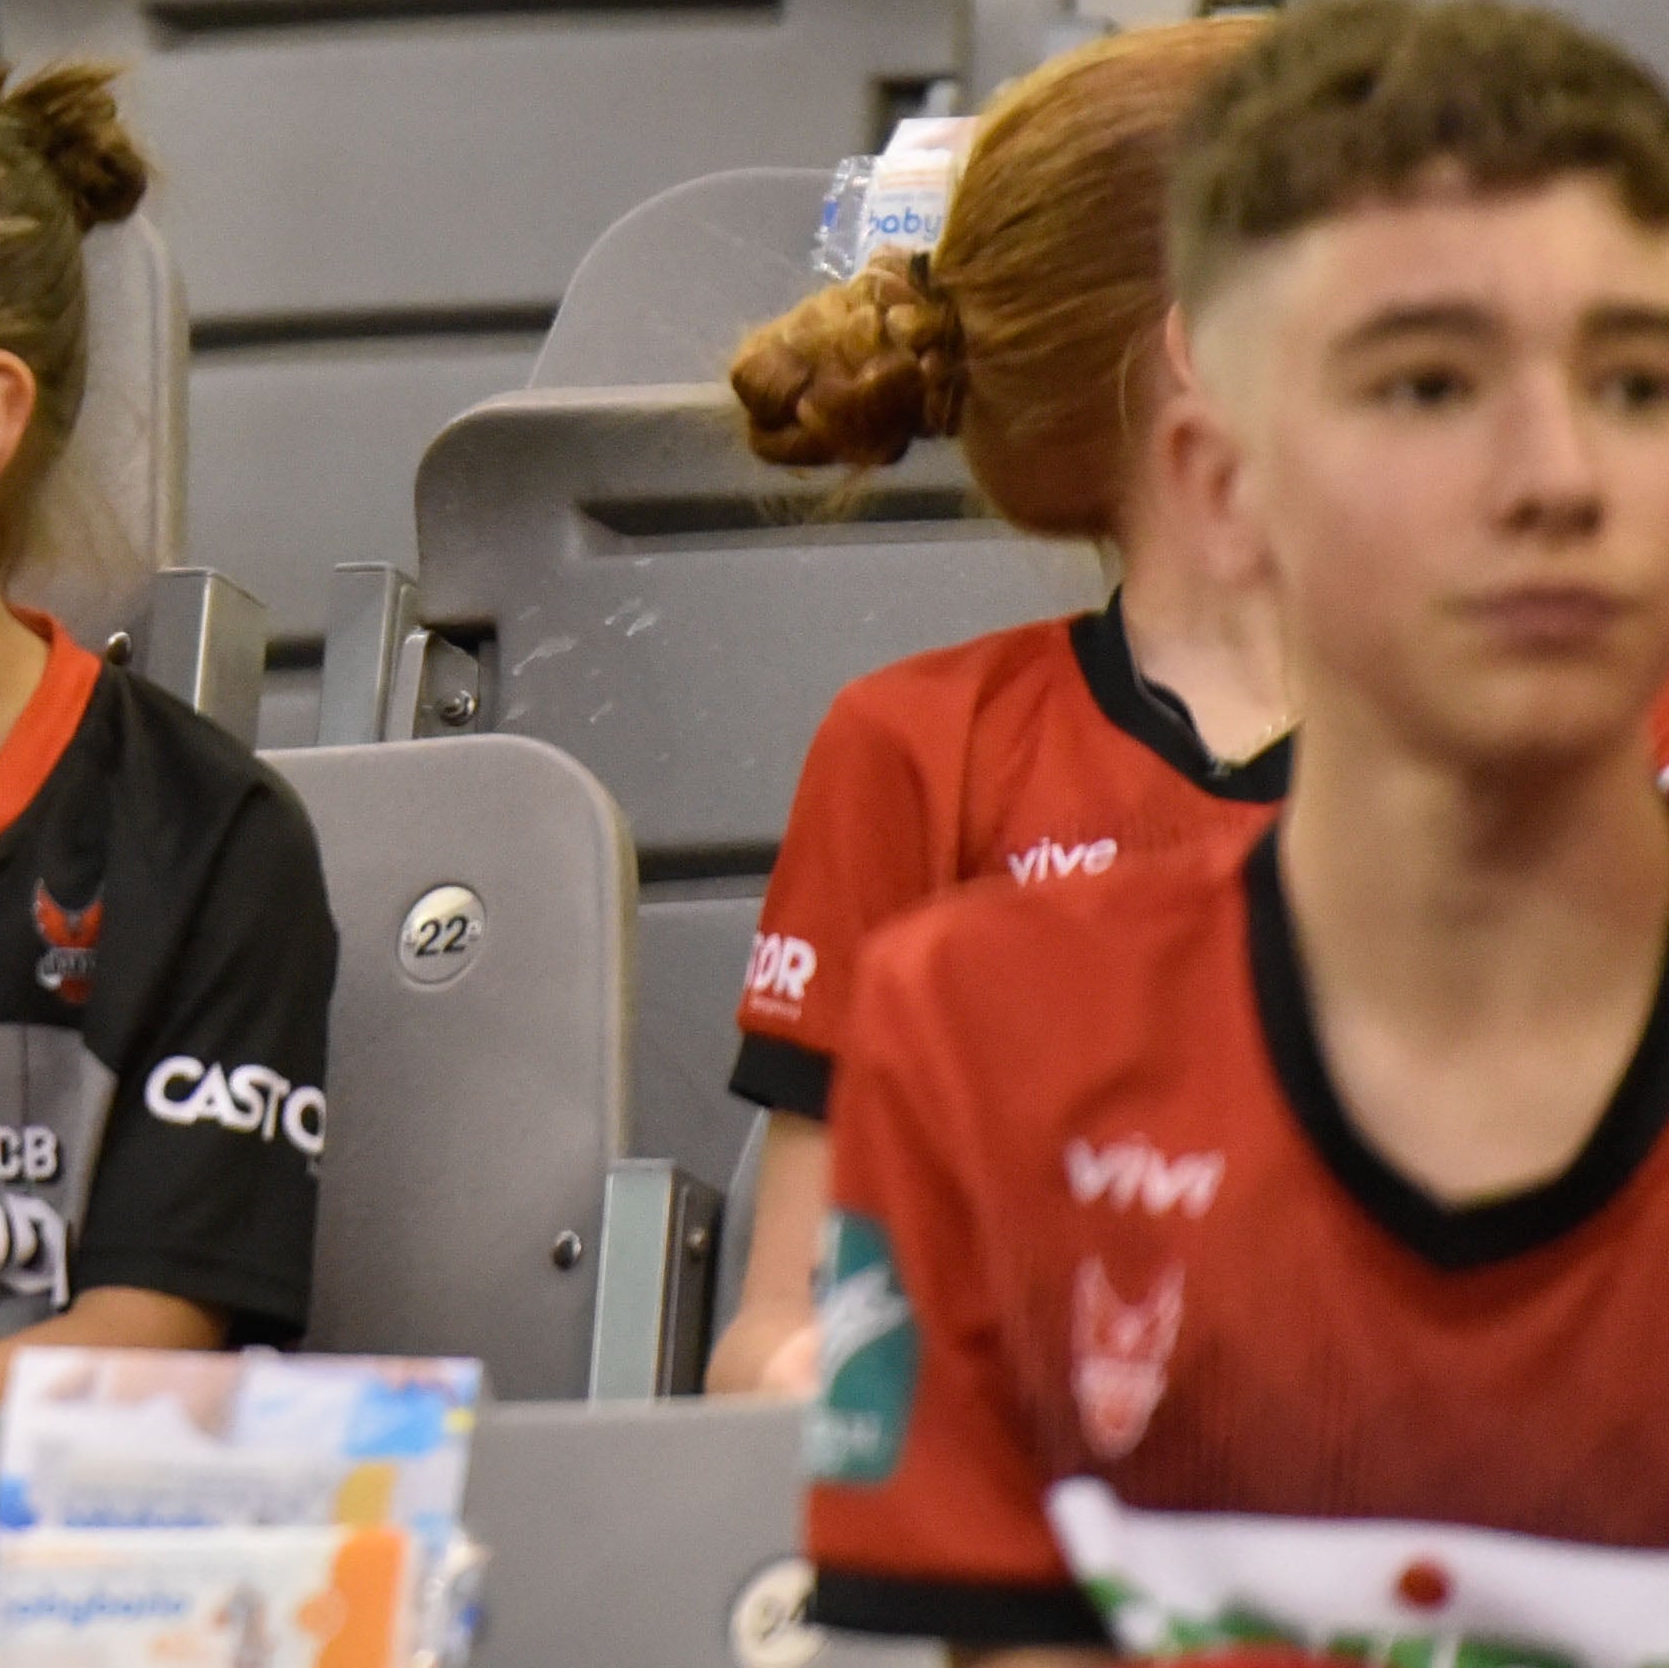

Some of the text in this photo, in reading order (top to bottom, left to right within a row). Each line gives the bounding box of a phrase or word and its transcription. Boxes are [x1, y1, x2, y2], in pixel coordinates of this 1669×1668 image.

[1006, 836, 1118, 887] vive
[415, 915, 468, 957] 22
[145, 1054, 327, 1155] CASTO
